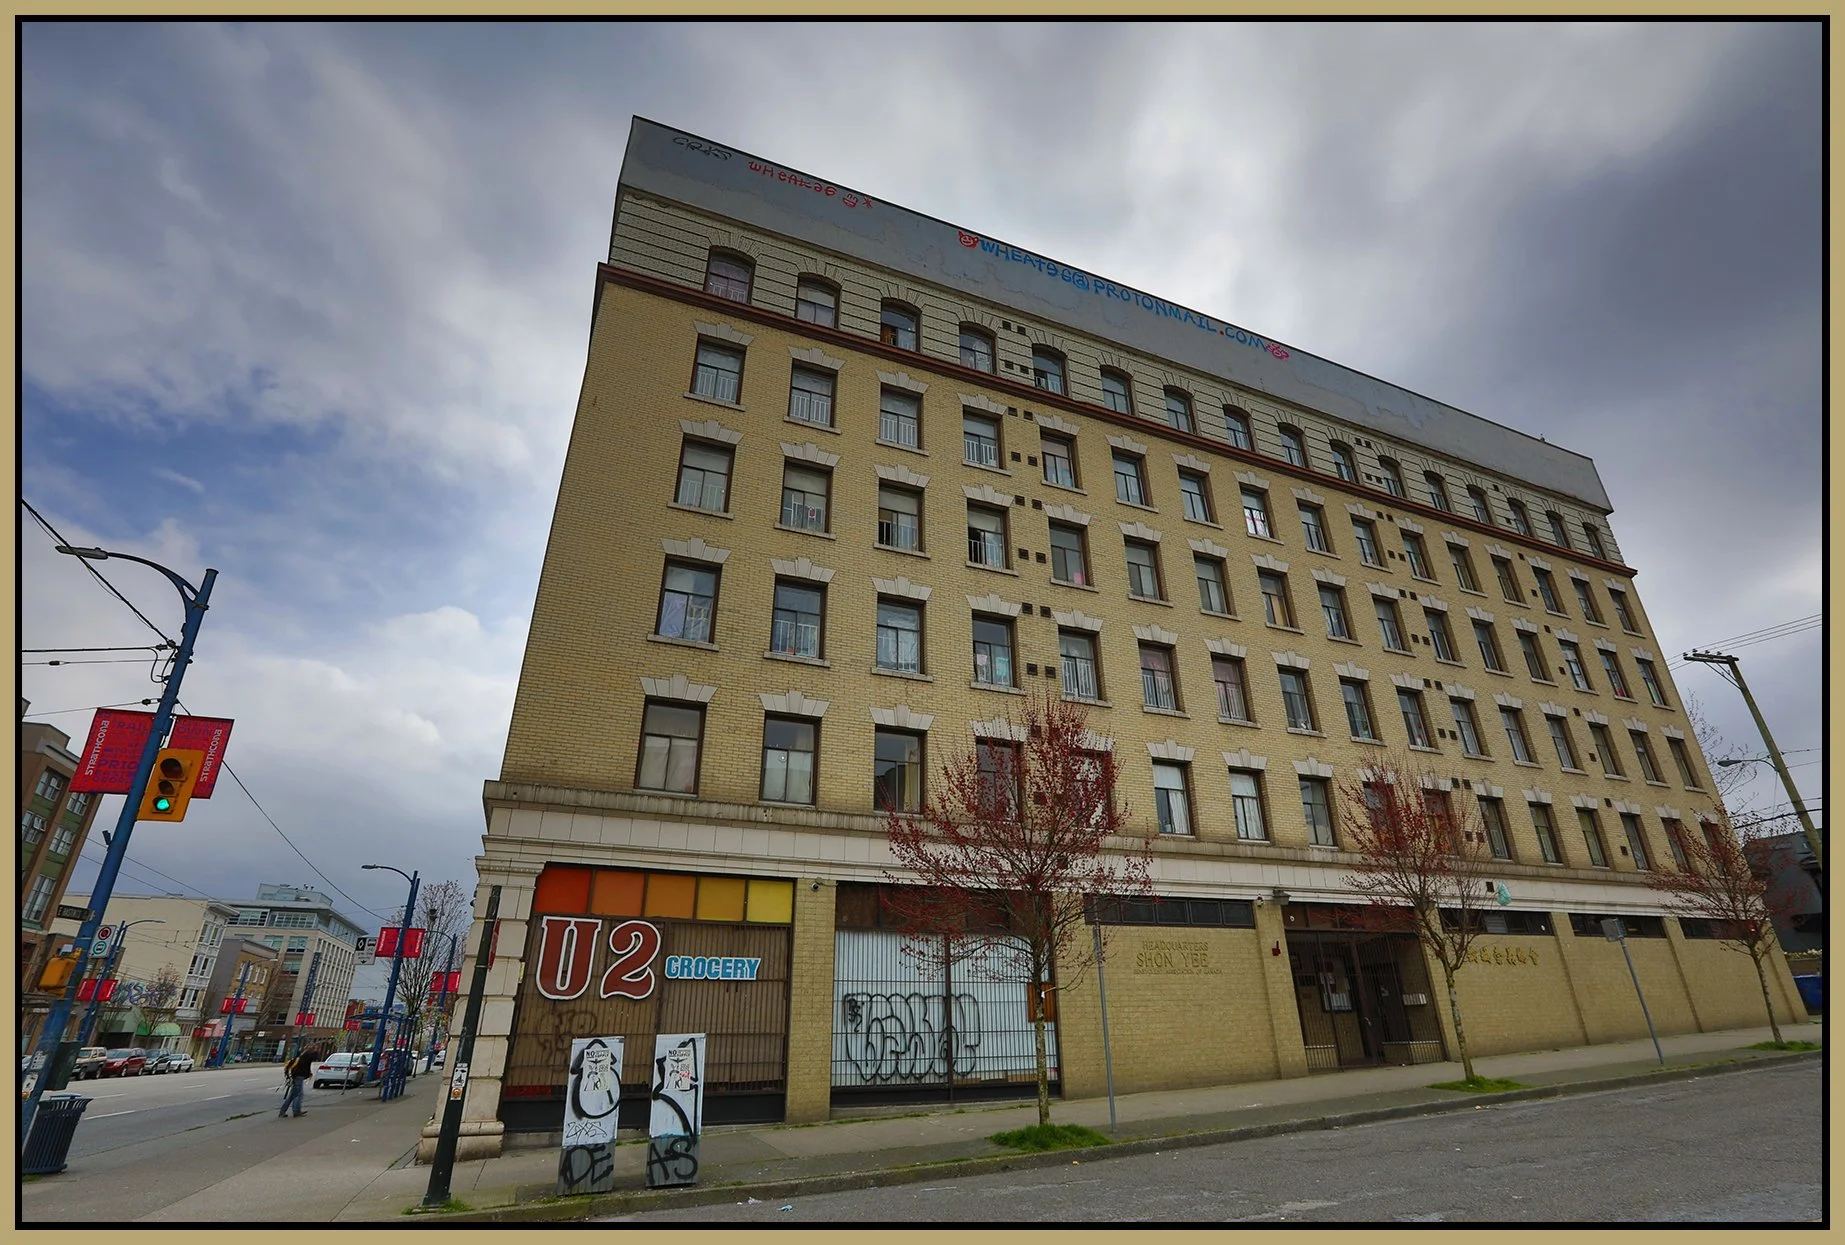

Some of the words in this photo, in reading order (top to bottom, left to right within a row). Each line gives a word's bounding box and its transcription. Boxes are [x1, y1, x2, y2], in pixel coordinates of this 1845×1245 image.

[536, 915, 661, 1000] U2
[665, 955, 761, 981] GROCERY
[1136, 952, 1174, 967] SHON
[1179, 952, 1209, 967] YEE
